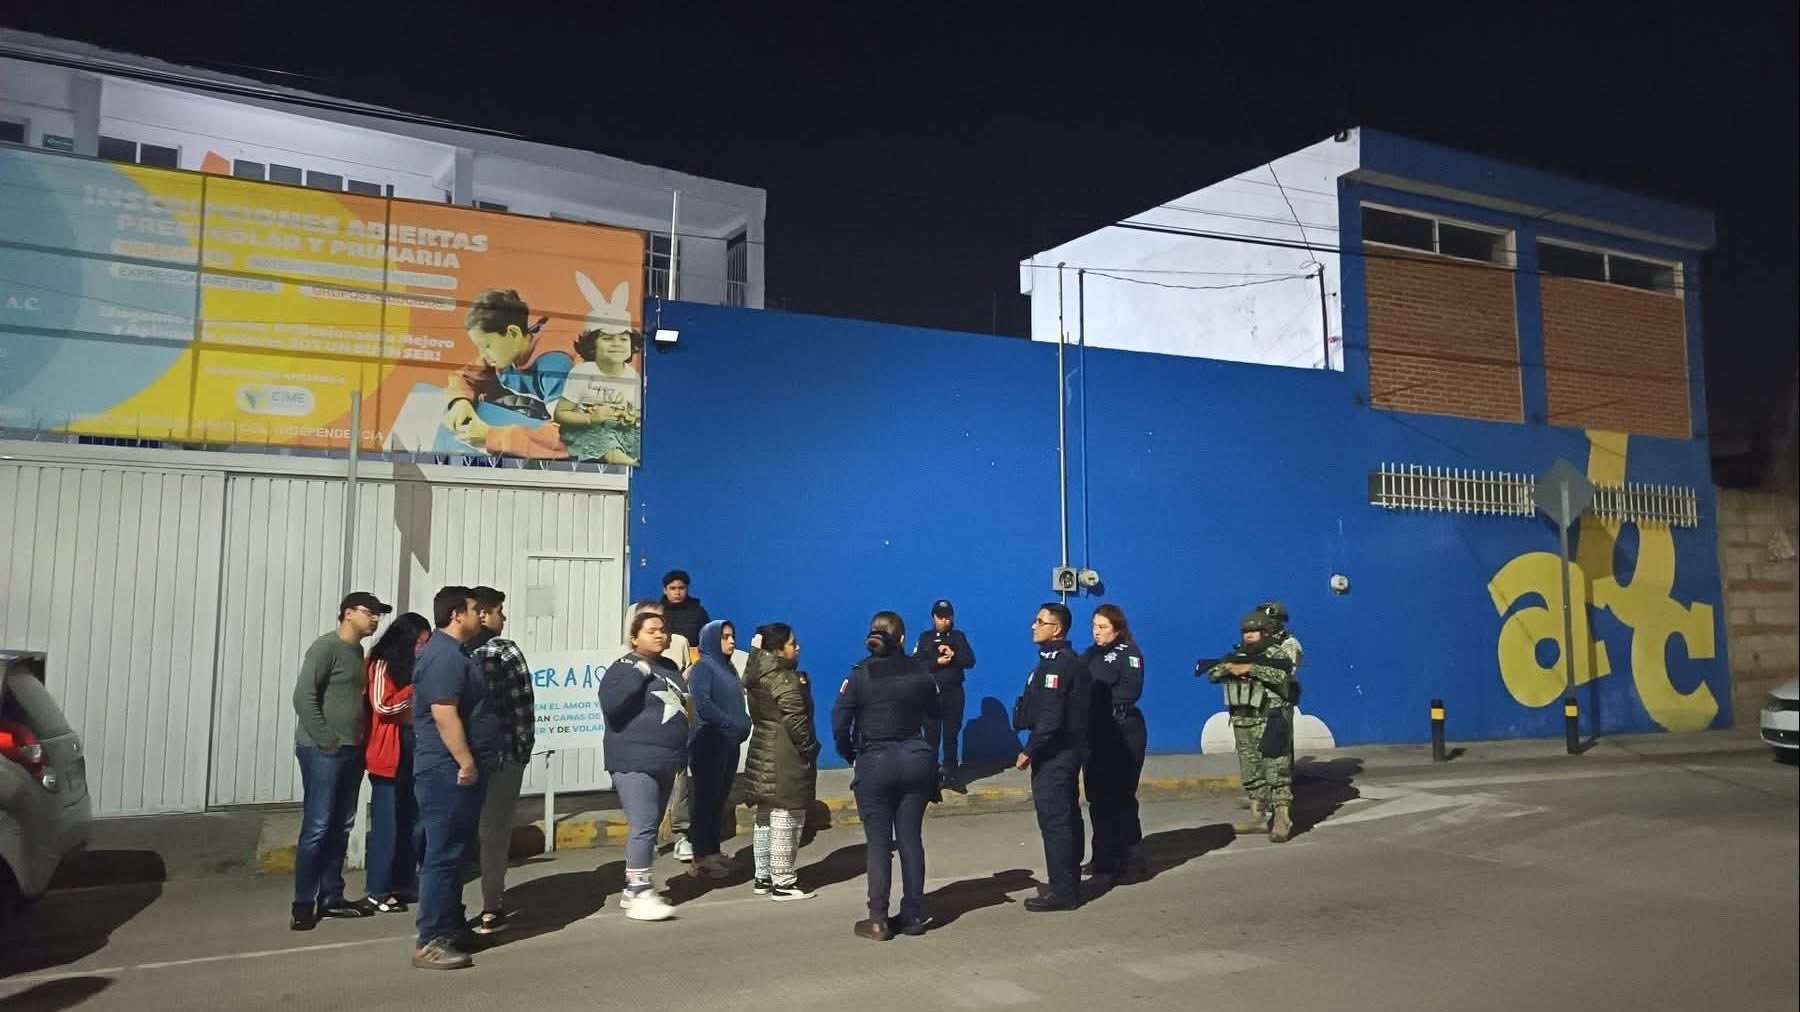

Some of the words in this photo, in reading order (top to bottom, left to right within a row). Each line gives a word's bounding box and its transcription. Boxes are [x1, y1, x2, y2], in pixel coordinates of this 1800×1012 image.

[347, 220, 489, 252] ABIERTAS
[308, 237, 325, 253] Y
[331, 241, 460, 269] PRIMARIA
[529, 668, 559, 688] ER
[564, 668, 577, 687] A
[563, 701, 592, 710] AMOR
[548, 726, 555, 734] Y
[557, 726, 570, 734] DE
